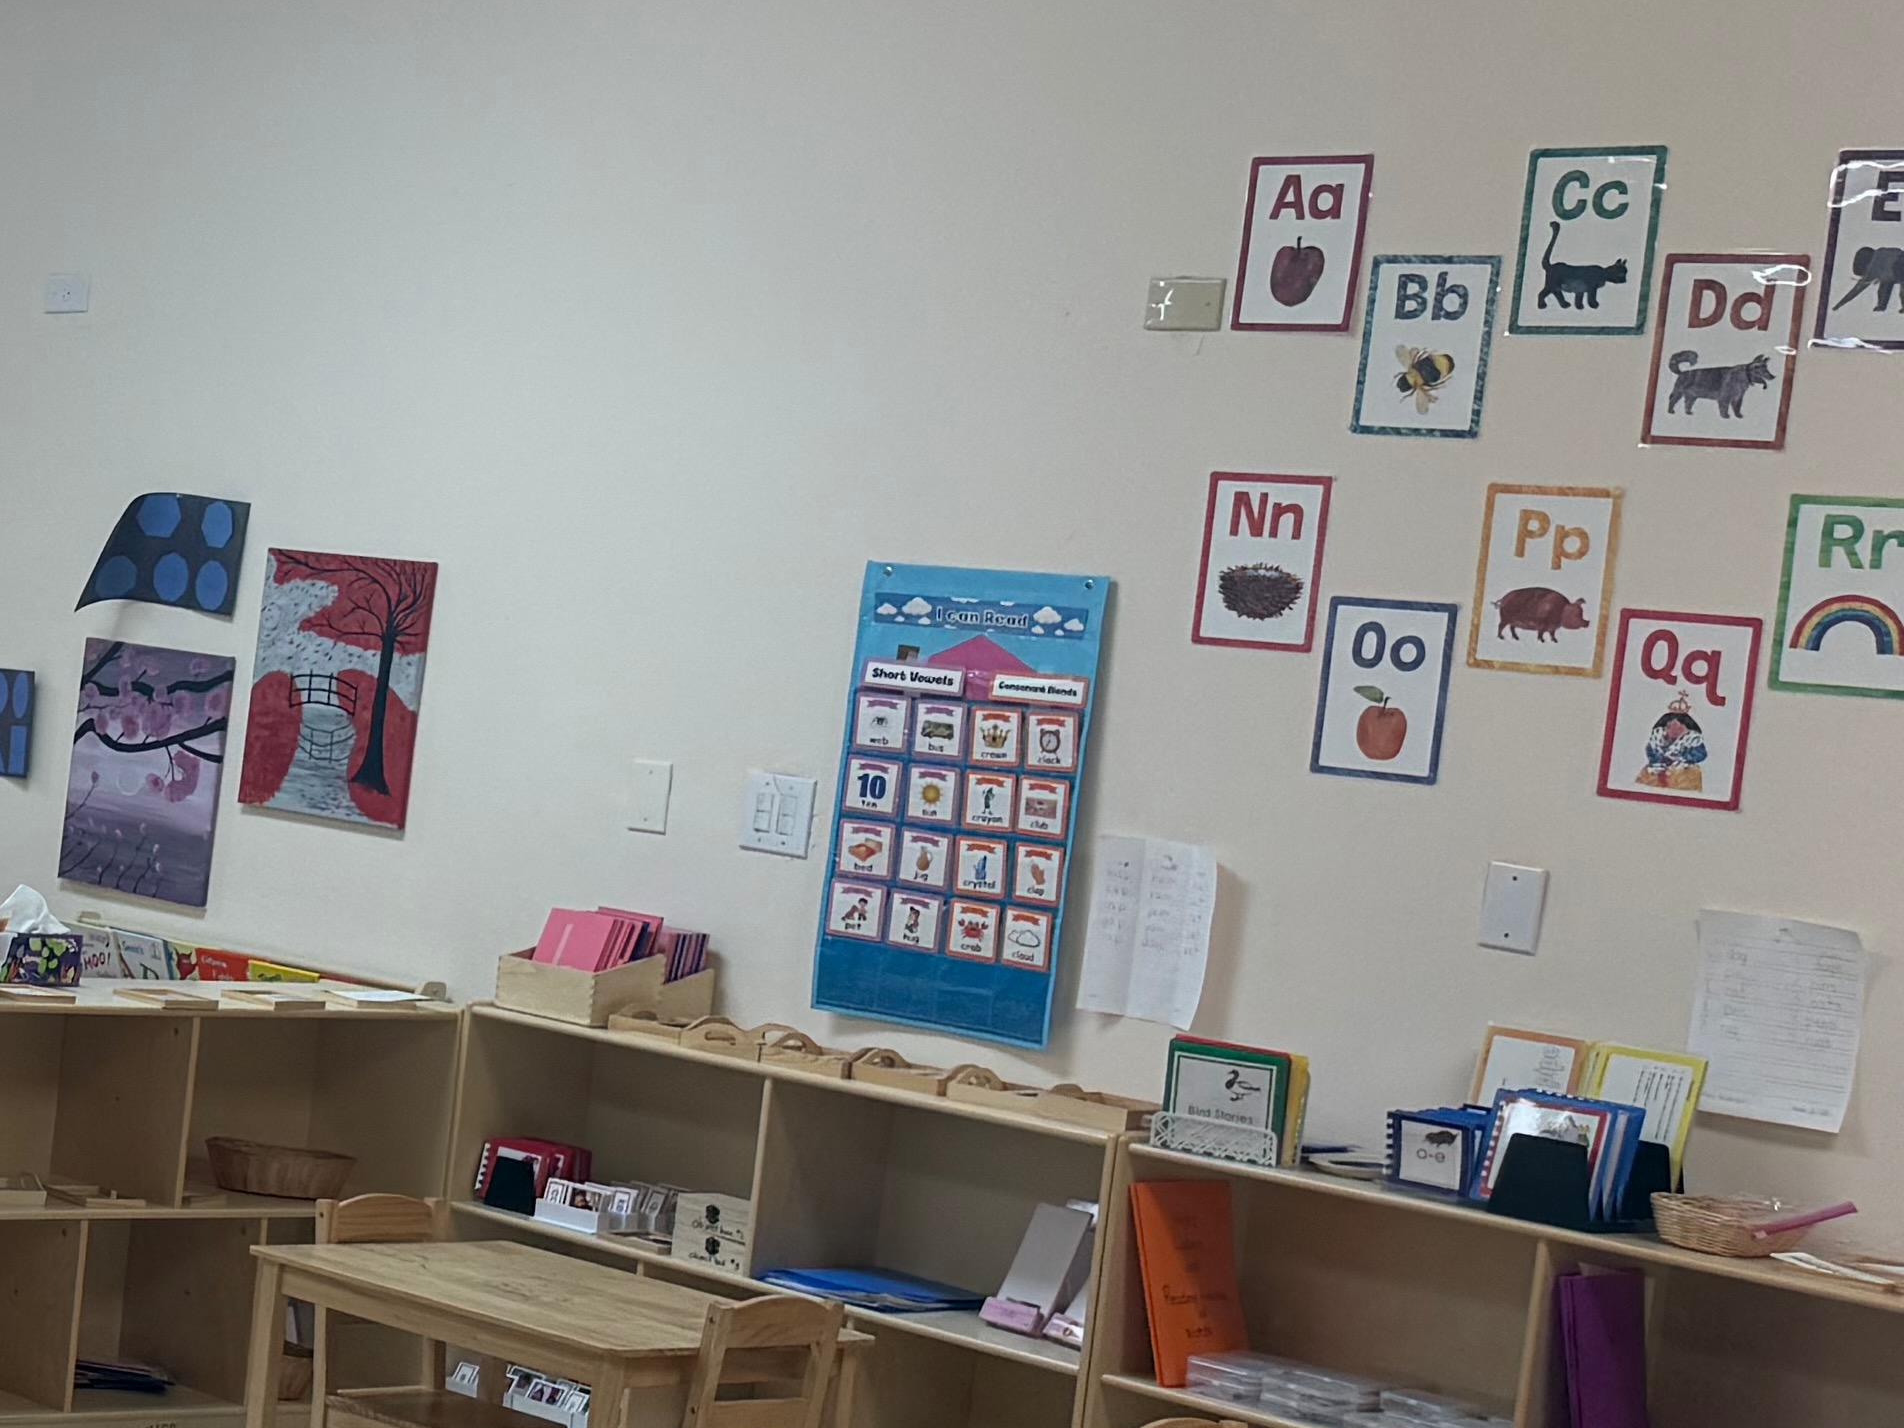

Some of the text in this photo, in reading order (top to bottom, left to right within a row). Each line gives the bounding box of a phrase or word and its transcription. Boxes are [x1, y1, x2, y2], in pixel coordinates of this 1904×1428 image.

[1269, 174, 1346, 221] Aa
[1551, 169, 1630, 221] Cc
[1393, 271, 1470, 322] Bb
[1687, 278, 1772, 332] Dd
[1228, 491, 1305, 540] Nn
[1513, 508, 1591, 570] Pp
[1818, 514, 1904, 569] Rr
[936, 608, 1030, 628] I can Read
[1351, 621, 1426, 672] Oo
[1639, 628, 1726, 707] Qq
[872, 668, 955, 687] Short Vowels
[857, 773, 887, 800] 10
